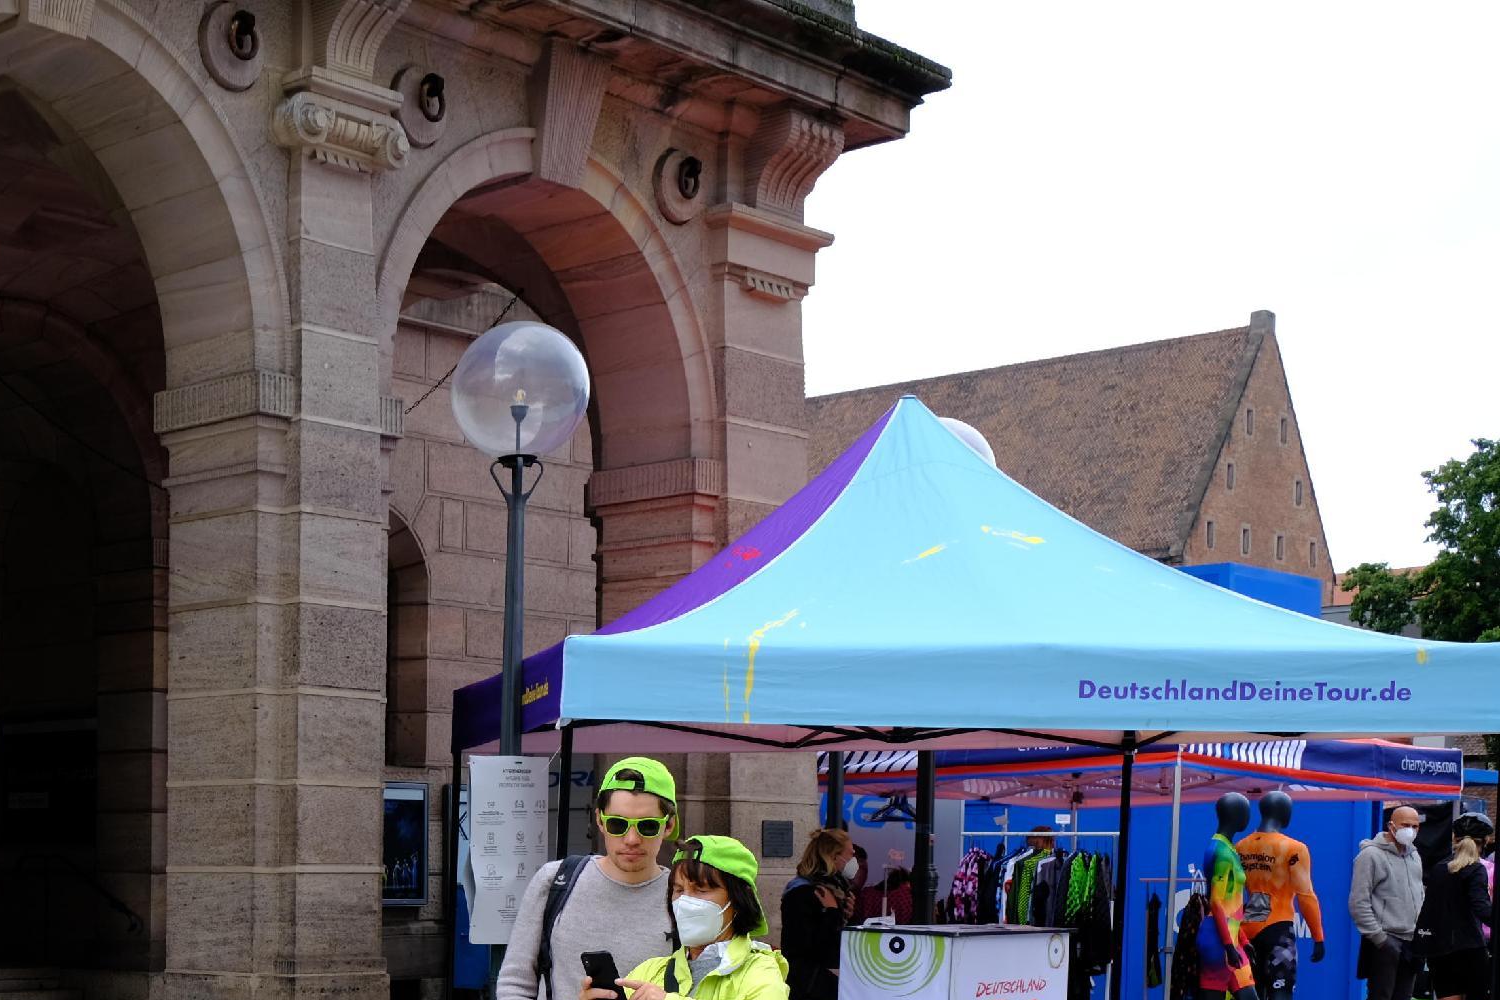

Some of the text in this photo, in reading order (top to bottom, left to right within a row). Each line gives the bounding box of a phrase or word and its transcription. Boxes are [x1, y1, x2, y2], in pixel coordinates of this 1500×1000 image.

[1078, 679, 1412, 701] DeutschlandDeineTour.de
[1401, 755, 1458, 776] champ-sys.com
[1240, 852, 1276, 864] hampion
[975, 977, 1047, 998] DEUTSCHLAND
